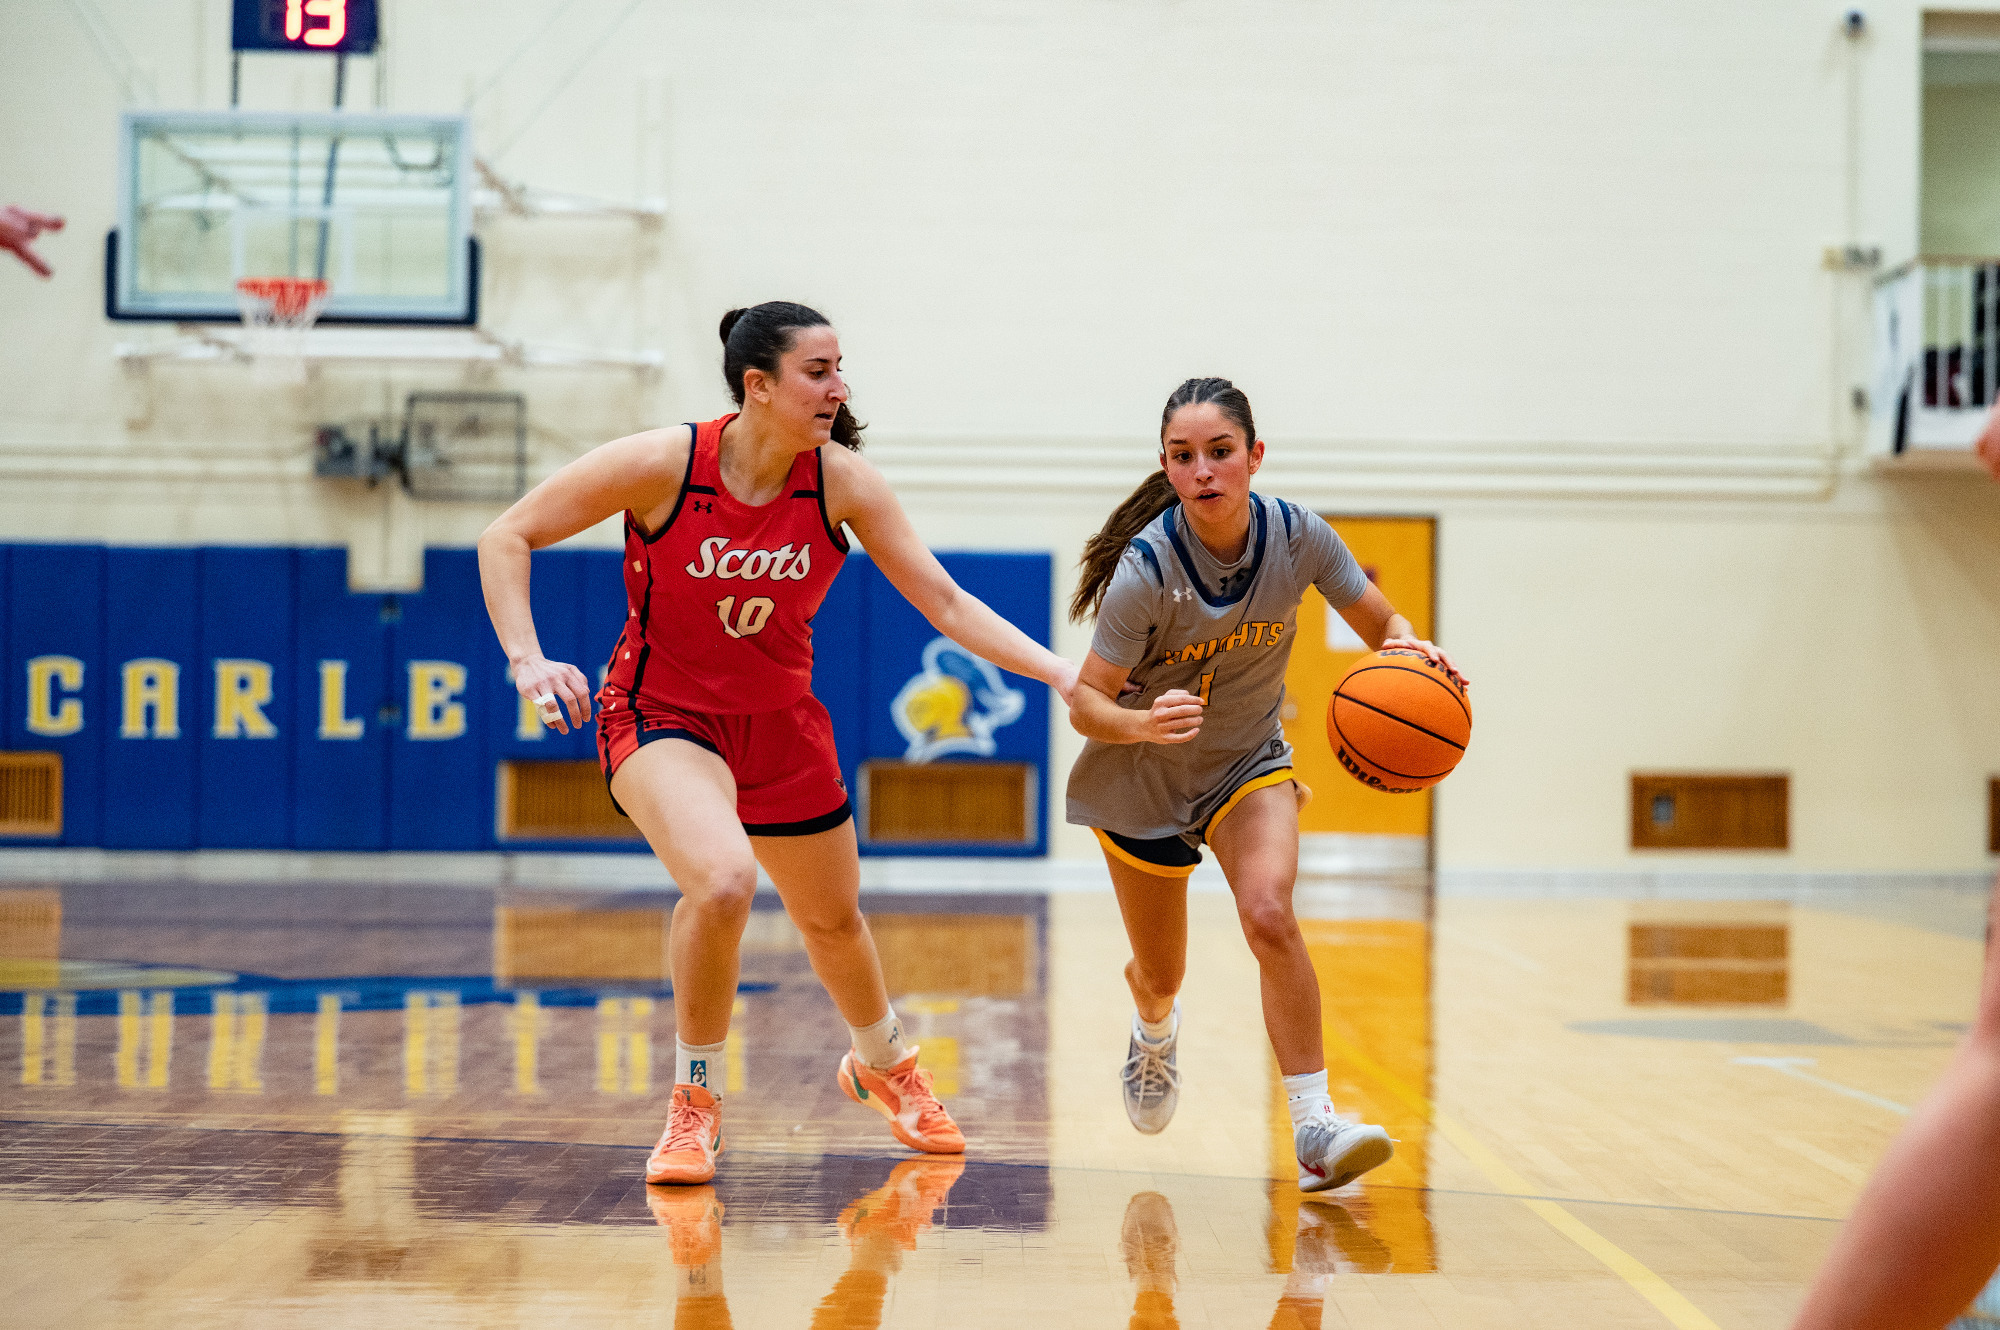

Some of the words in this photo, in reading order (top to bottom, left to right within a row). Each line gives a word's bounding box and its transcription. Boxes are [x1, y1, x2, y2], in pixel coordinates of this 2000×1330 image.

[685, 536, 812, 581] Scots
[716, 595, 775, 639] 10
[1197, 665, 1219, 706] 1
[1337, 745, 1423, 794] Wilson
